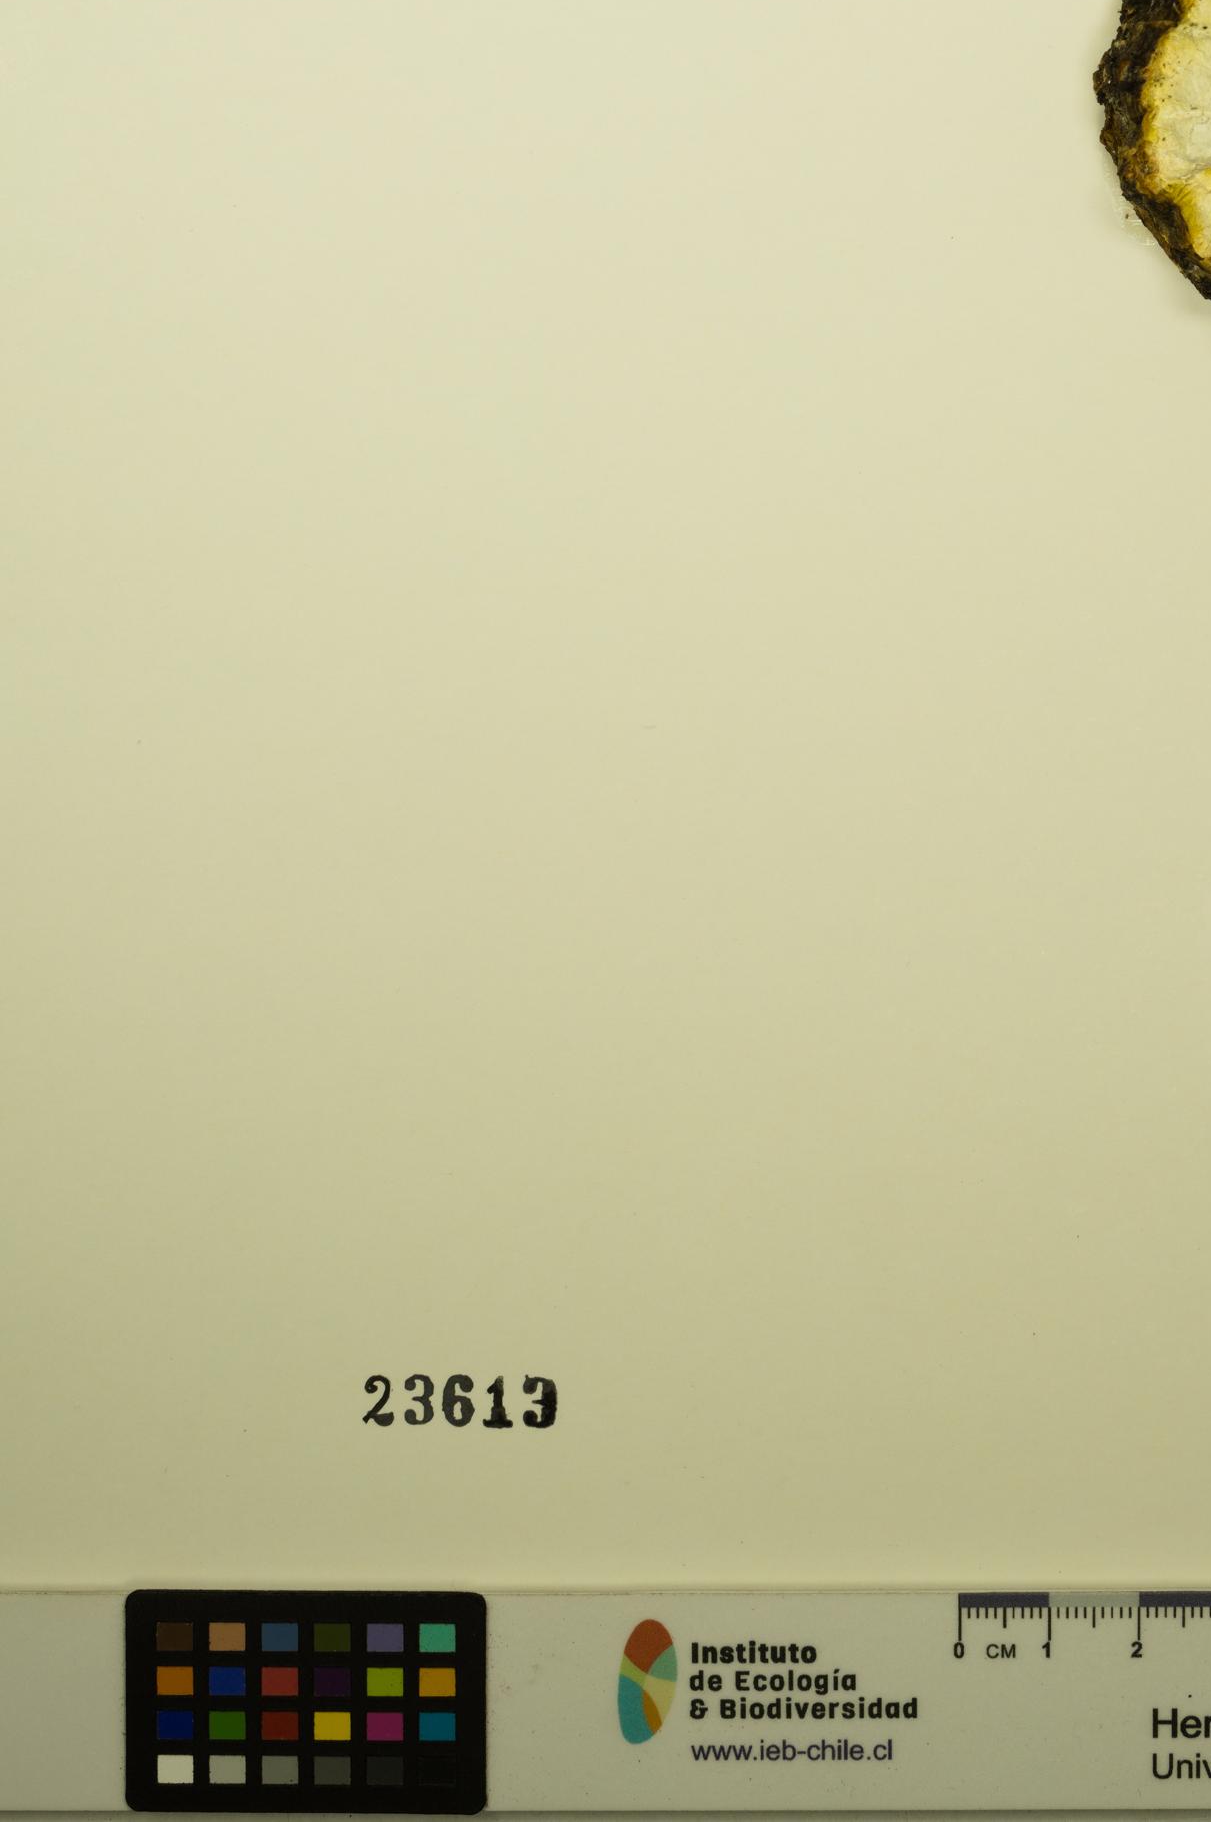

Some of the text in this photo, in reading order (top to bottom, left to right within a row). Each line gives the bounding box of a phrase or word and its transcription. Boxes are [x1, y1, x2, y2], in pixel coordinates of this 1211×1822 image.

[362, 1373, 558, 1430] 23613
[690, 1640, 818, 1665] Instituto
[953, 1641, 965, 1660] 0
[985, 1643, 1017, 1660] CM
[1041, 1641, 1052, 1659] 1
[1130, 1640, 1143, 1659] 2
[689, 1668, 857, 1696] de Ecología
[689, 1696, 918, 1720] & Biodiversidad
[690, 1738, 893, 1762] www.ieb-chile.cl
